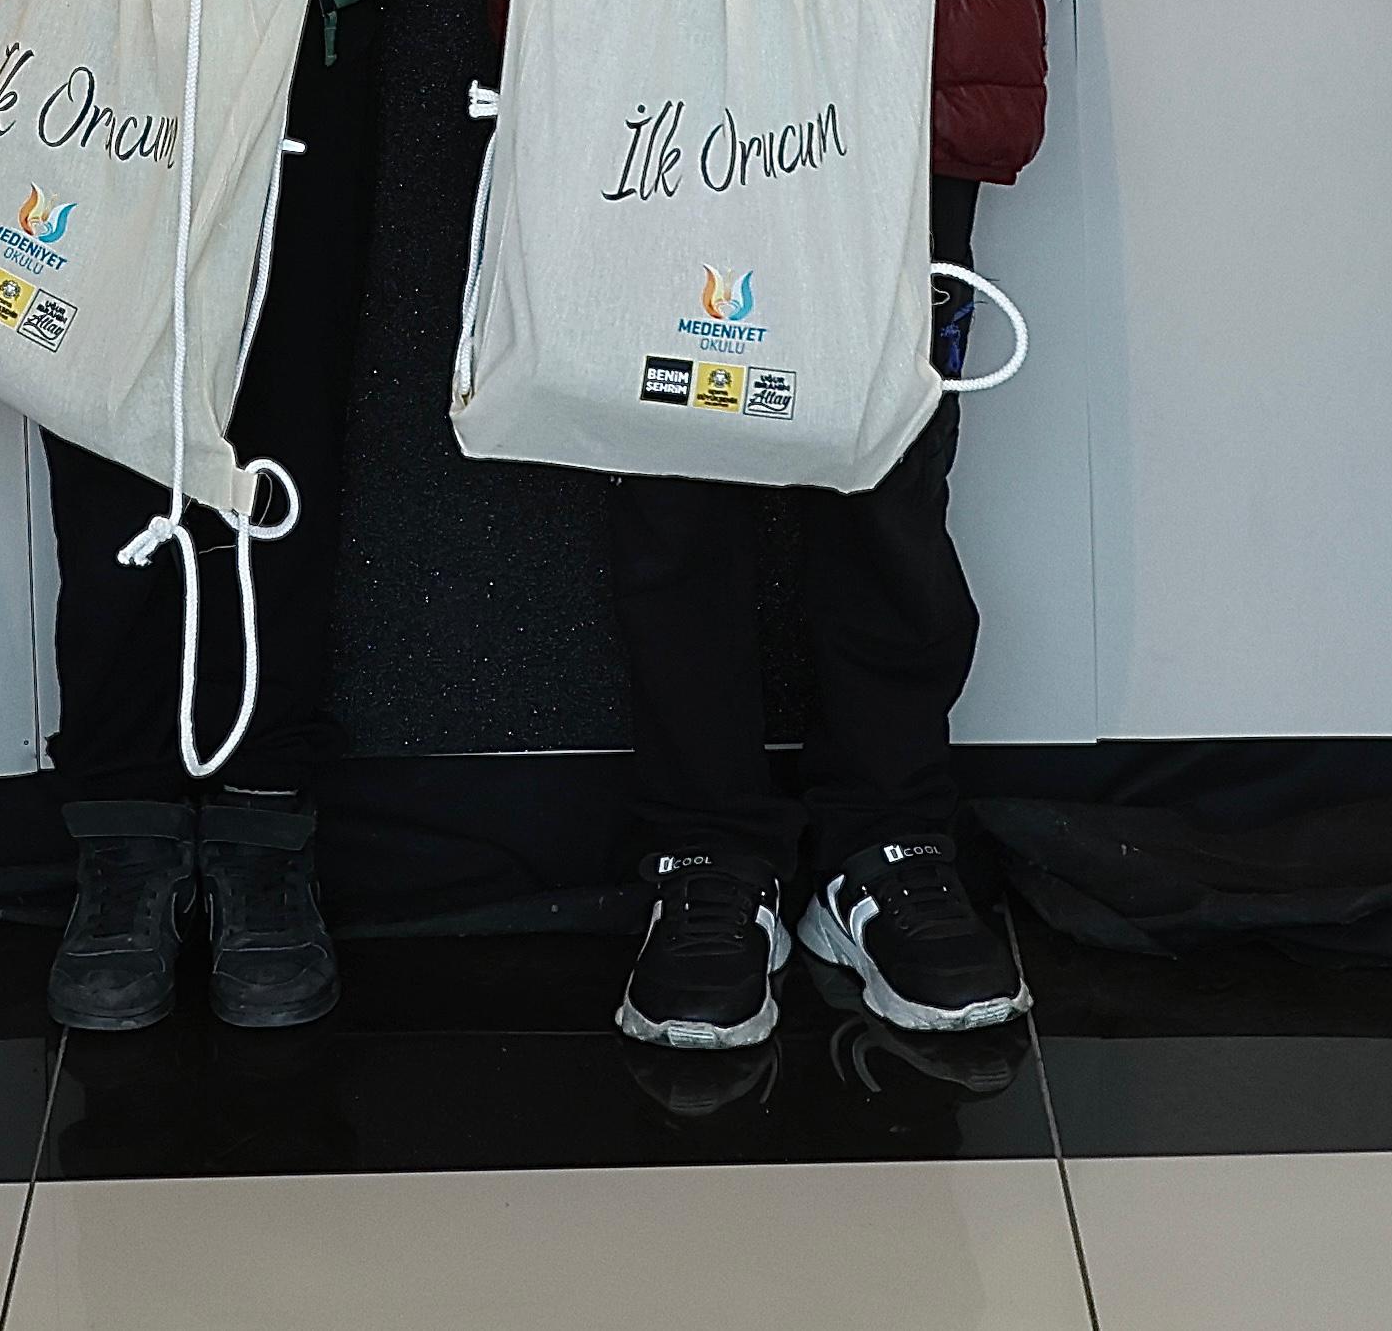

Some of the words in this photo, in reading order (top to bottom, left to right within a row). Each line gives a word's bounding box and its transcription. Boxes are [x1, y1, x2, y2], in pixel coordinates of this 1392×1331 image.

[601, 100, 685, 201] İlk
[3, 246, 45, 275] OKULU
[678, 318, 767, 342] MEDENİYET
[700, 338, 745, 355] OKULU
[647, 368, 689, 384] BENİM
